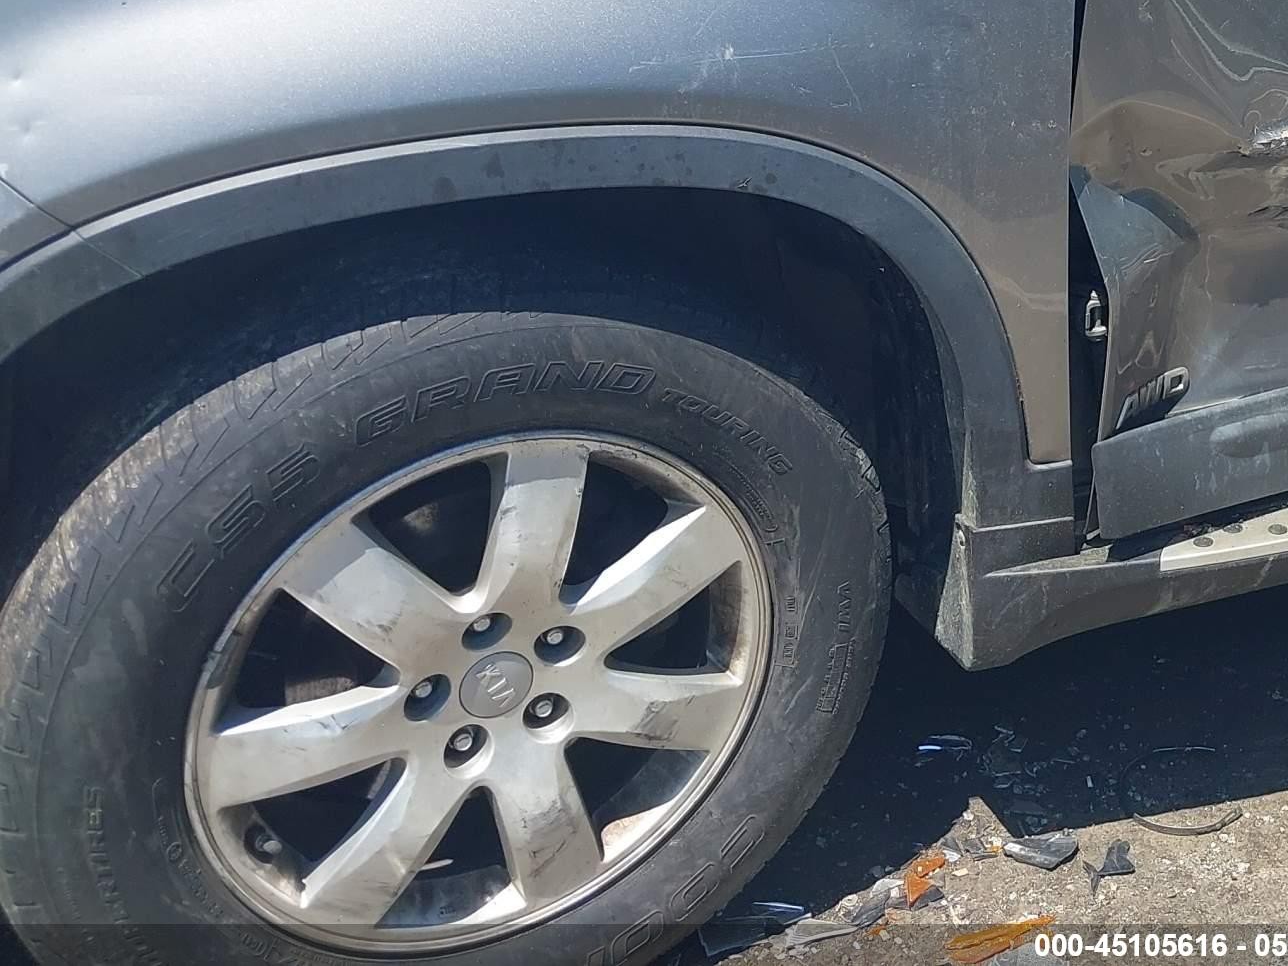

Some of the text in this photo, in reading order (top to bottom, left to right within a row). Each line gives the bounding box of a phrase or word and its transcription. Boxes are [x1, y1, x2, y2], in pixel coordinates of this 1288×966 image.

[156, 360, 793, 613] CS5 GRAND TOURING
[475, 664, 516, 708] KIA
